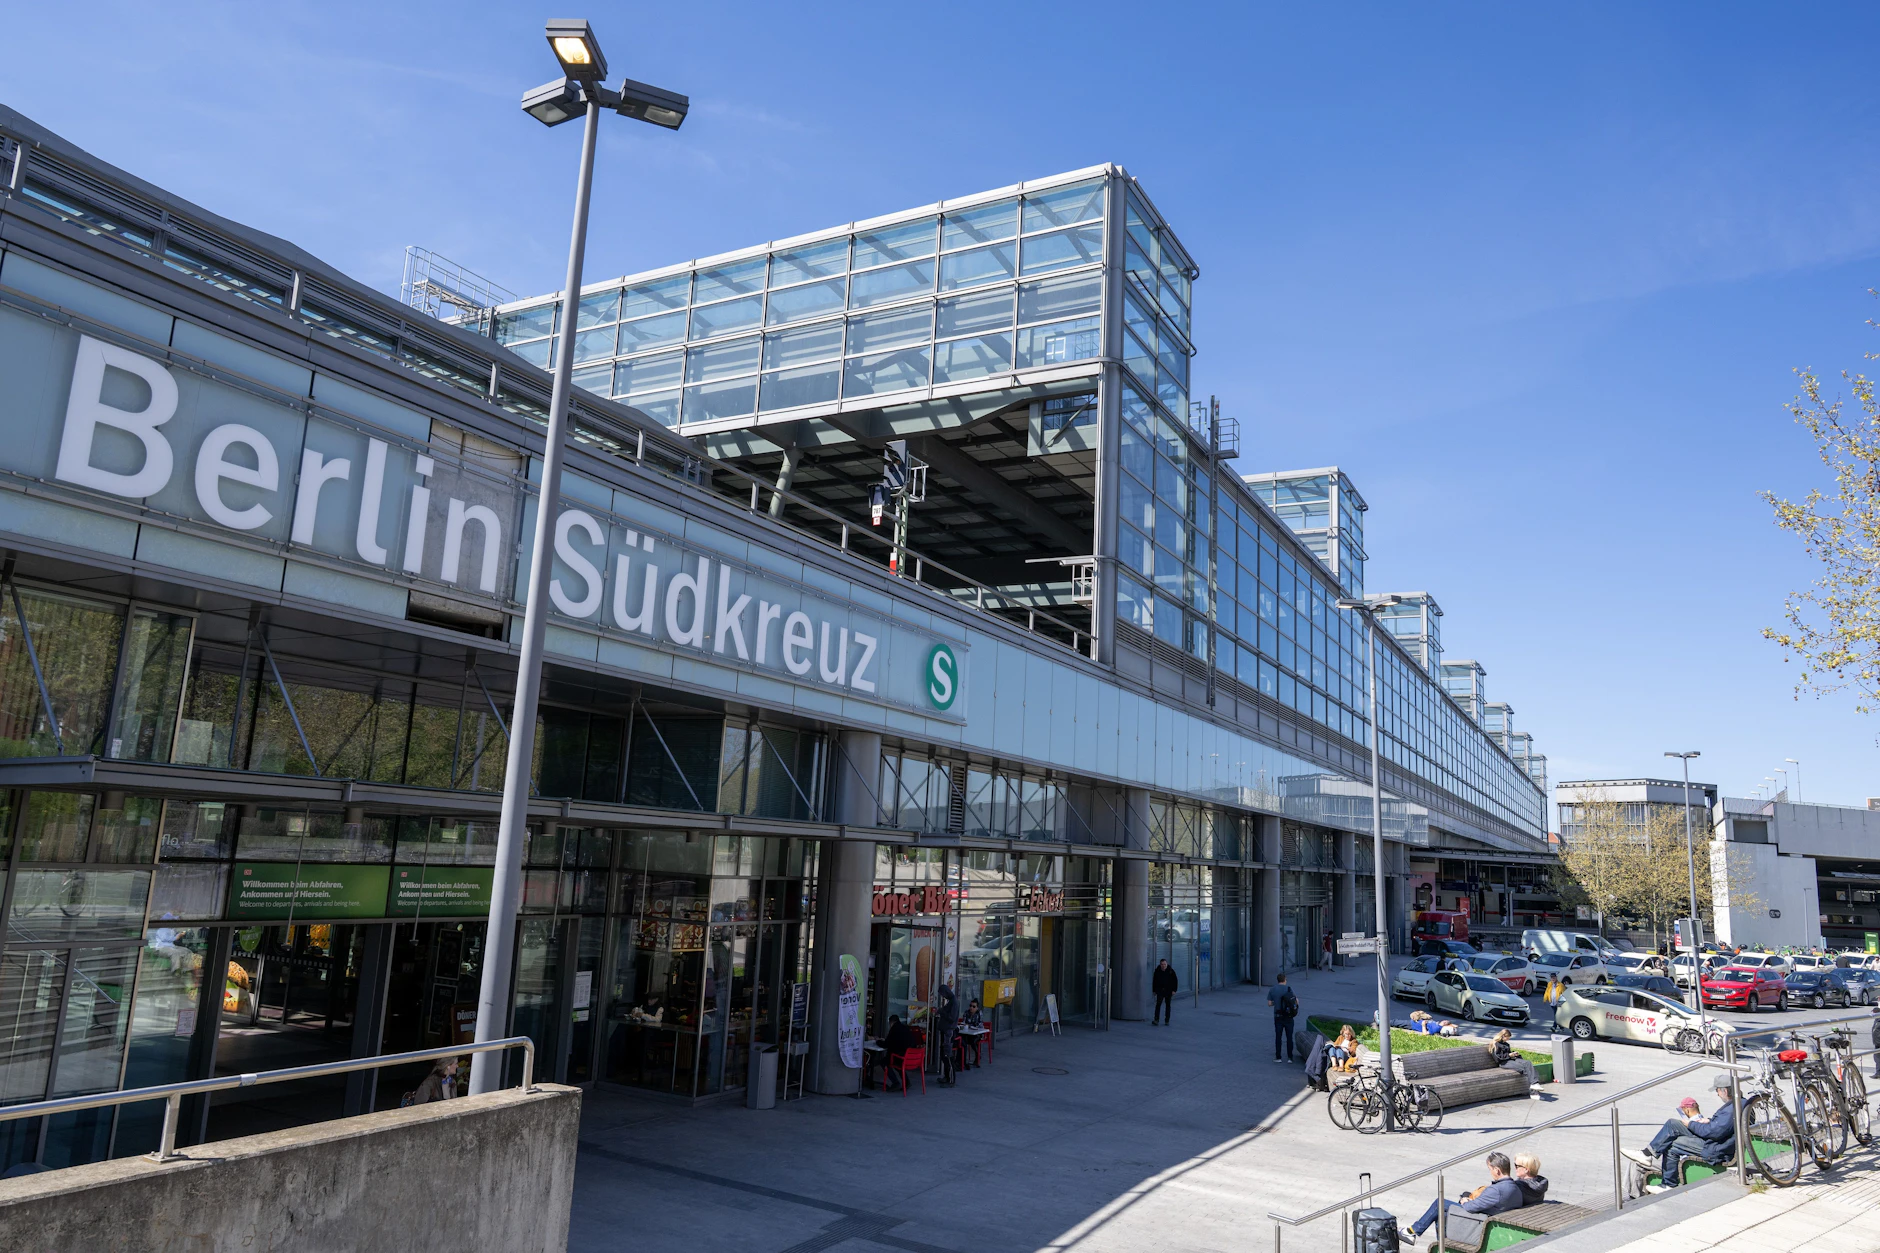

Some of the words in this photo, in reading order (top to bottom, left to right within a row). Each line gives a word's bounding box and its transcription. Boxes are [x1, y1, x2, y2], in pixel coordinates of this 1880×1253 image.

[55, 333, 503, 594] Berlin
[548, 508, 878, 693] Südkreuz
[930, 650, 953, 704] S
[242, 880, 289, 889] Willkommen
[290, 881, 308, 889] beim
[309, 881, 344, 889] Abfahren,
[399, 881, 437, 889] Willkommen
[452, 882, 480, 890] Abfahren,
[240, 890, 283, 898] Ankommen
[284, 890, 299, 898] und
[300, 890, 331, 898] Hiersein.
[872, 885, 921, 915] öner
[922, 886, 953, 913] Biz
[1029, 885, 1065, 912] Eckert
[333, 900, 348, 908] being
[1605, 1011, 1645, 1024] freenow
